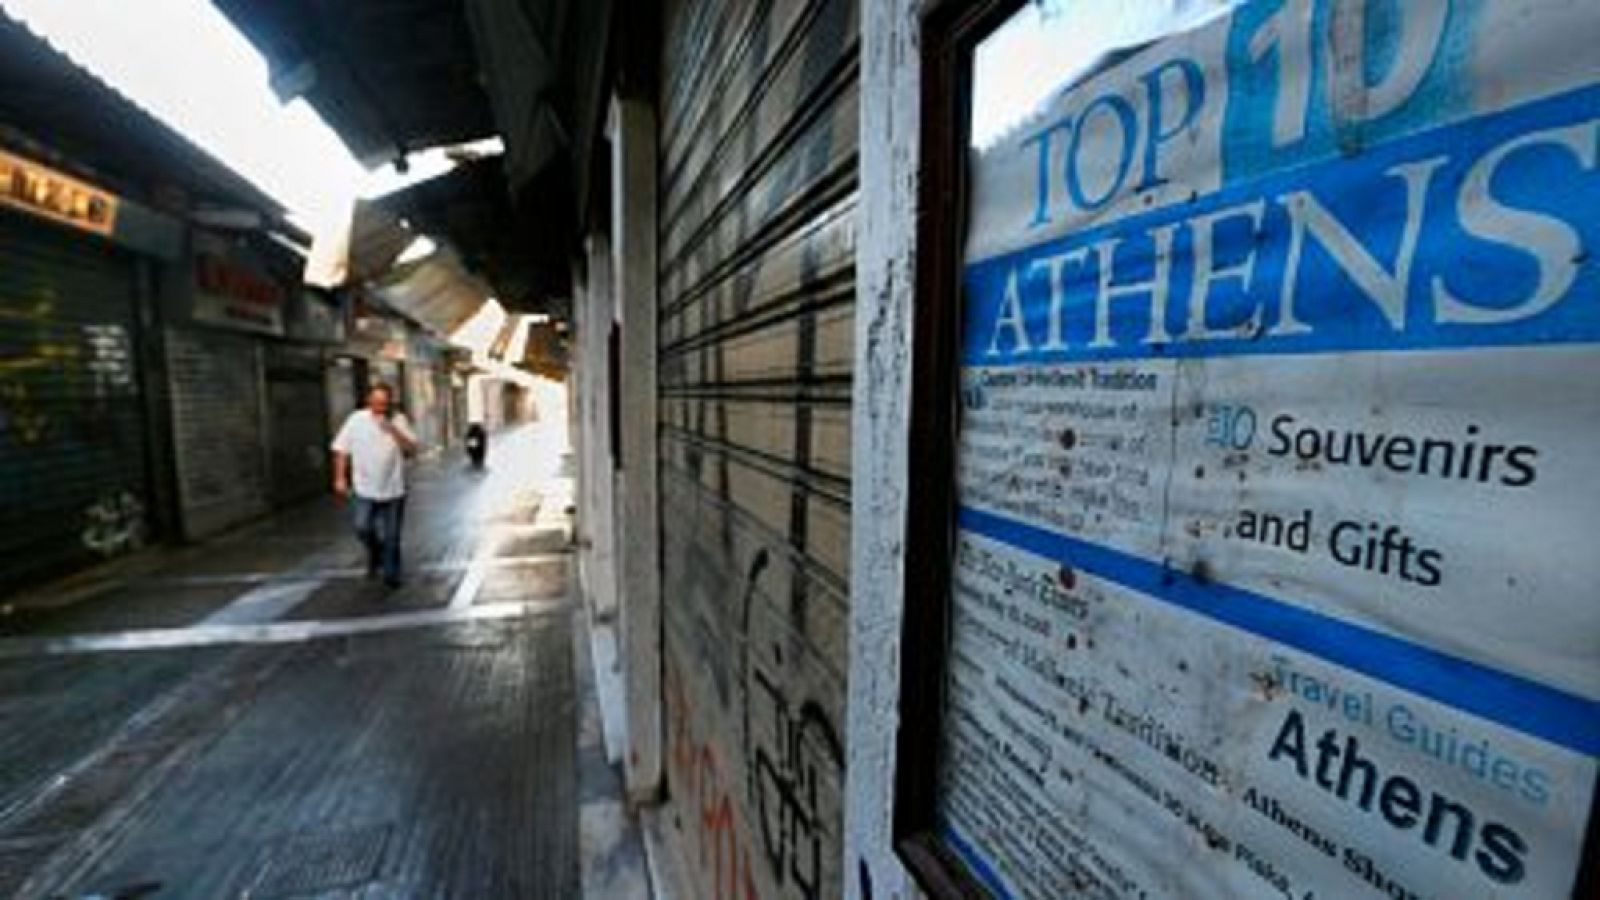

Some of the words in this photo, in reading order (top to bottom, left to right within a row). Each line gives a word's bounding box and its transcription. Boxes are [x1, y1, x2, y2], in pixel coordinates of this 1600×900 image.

[1021, 58, 1206, 230] TOP
[1248, 0, 1450, 150] 10
[986, 120, 1600, 357] ATHENS
[1267, 413, 1538, 487] Souvenirs
[1236, 509, 1313, 554] and
[1328, 521, 1444, 588] Gifts
[1268, 708, 1529, 885] Athens
[1272, 656, 1373, 726] Travel
[1386, 704, 1551, 808] Guides
[1242, 786, 1337, 858] Athens
[1343, 847, 1422, 900] Sho
